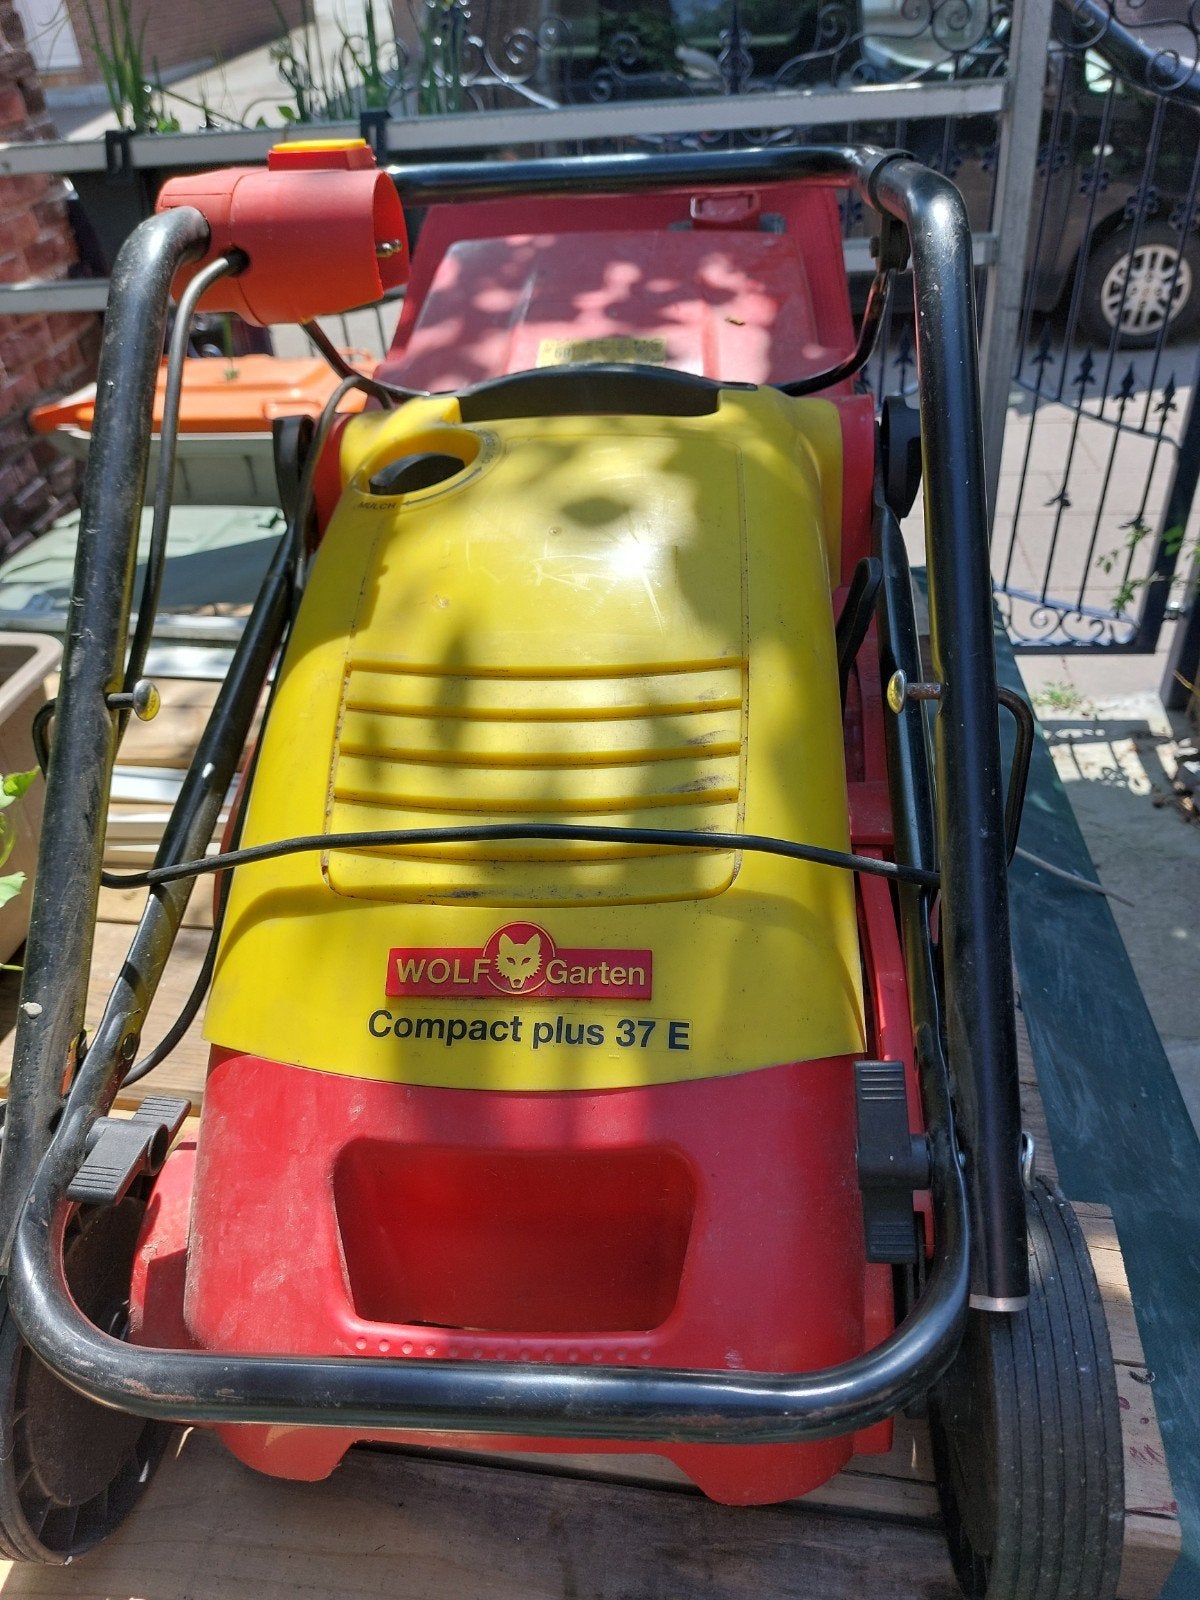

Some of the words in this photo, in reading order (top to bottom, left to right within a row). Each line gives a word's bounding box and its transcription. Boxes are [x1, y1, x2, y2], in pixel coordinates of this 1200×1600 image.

[396, 958, 491, 984] WOLF
[545, 959, 646, 985] Garten
[368, 1009, 523, 1048] Compact
[532, 1016, 605, 1050] plus
[615, 1019, 657, 1048] 37
[668, 1021, 690, 1050] E
